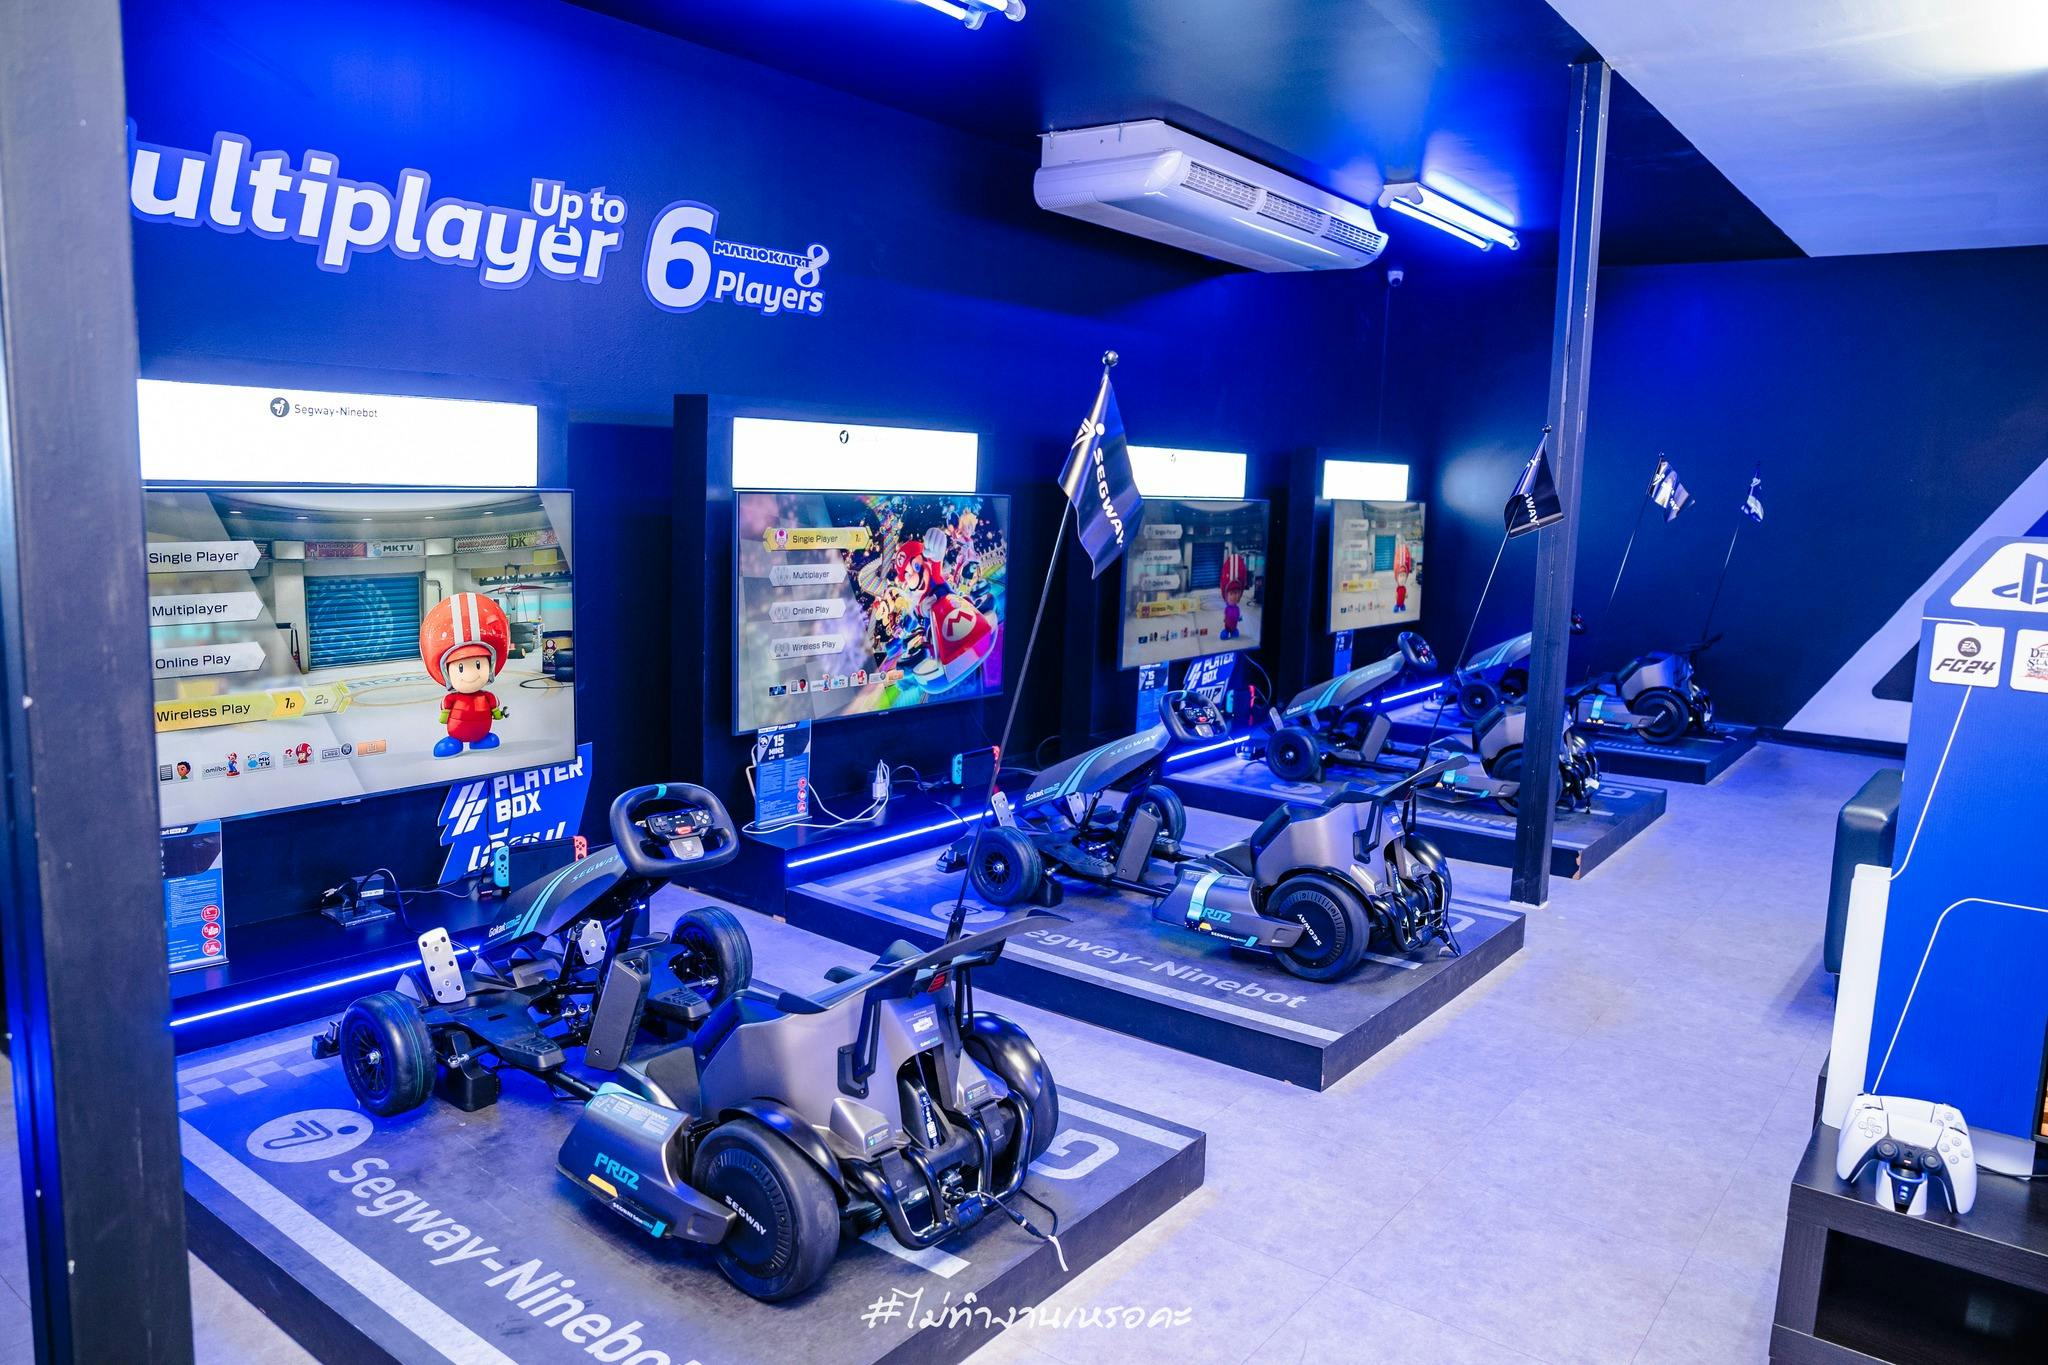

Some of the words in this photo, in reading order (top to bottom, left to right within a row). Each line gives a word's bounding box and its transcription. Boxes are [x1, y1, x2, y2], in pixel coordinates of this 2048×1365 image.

[130, 139, 620, 282] ultiplayer
[533, 182, 583, 228] Up
[590, 191, 626, 224] to
[646, 206, 714, 308] 6
[715, 270, 823, 312] Players
[294, 404, 378, 418] Segway-Ninebot
[1093, 447, 1125, 546] SEGWAY
[383, 544, 414, 552] MKTV
[792, 535, 814, 545] Single
[816, 534, 838, 545] Player
[149, 552, 192, 564] Single
[196, 551, 239, 562] Player
[792, 571, 830, 580] Multiplayer
[152, 602, 228, 617] Multiplayer
[792, 607, 814, 616] Online
[816, 606, 830, 616] Play
[792, 643, 821, 653] Wireless
[822, 640, 836, 651] Play
[155, 656, 199, 669] Online
[203, 654, 231, 667] Play
[157, 707, 218, 722] Wireless
[222, 703, 251, 717] Play
[773, 734, 785, 747] 15
[493, 756, 584, 799] PLAYER
[495, 790, 541, 823] BOX
[1297, 913, 1322, 947] SEGWAY
[1025, 928, 1309, 1009] egway-Ninebot
[725, 1195, 768, 1236] SEGWAY
[328, 1157, 703, 1365] Segway-Ninebo
